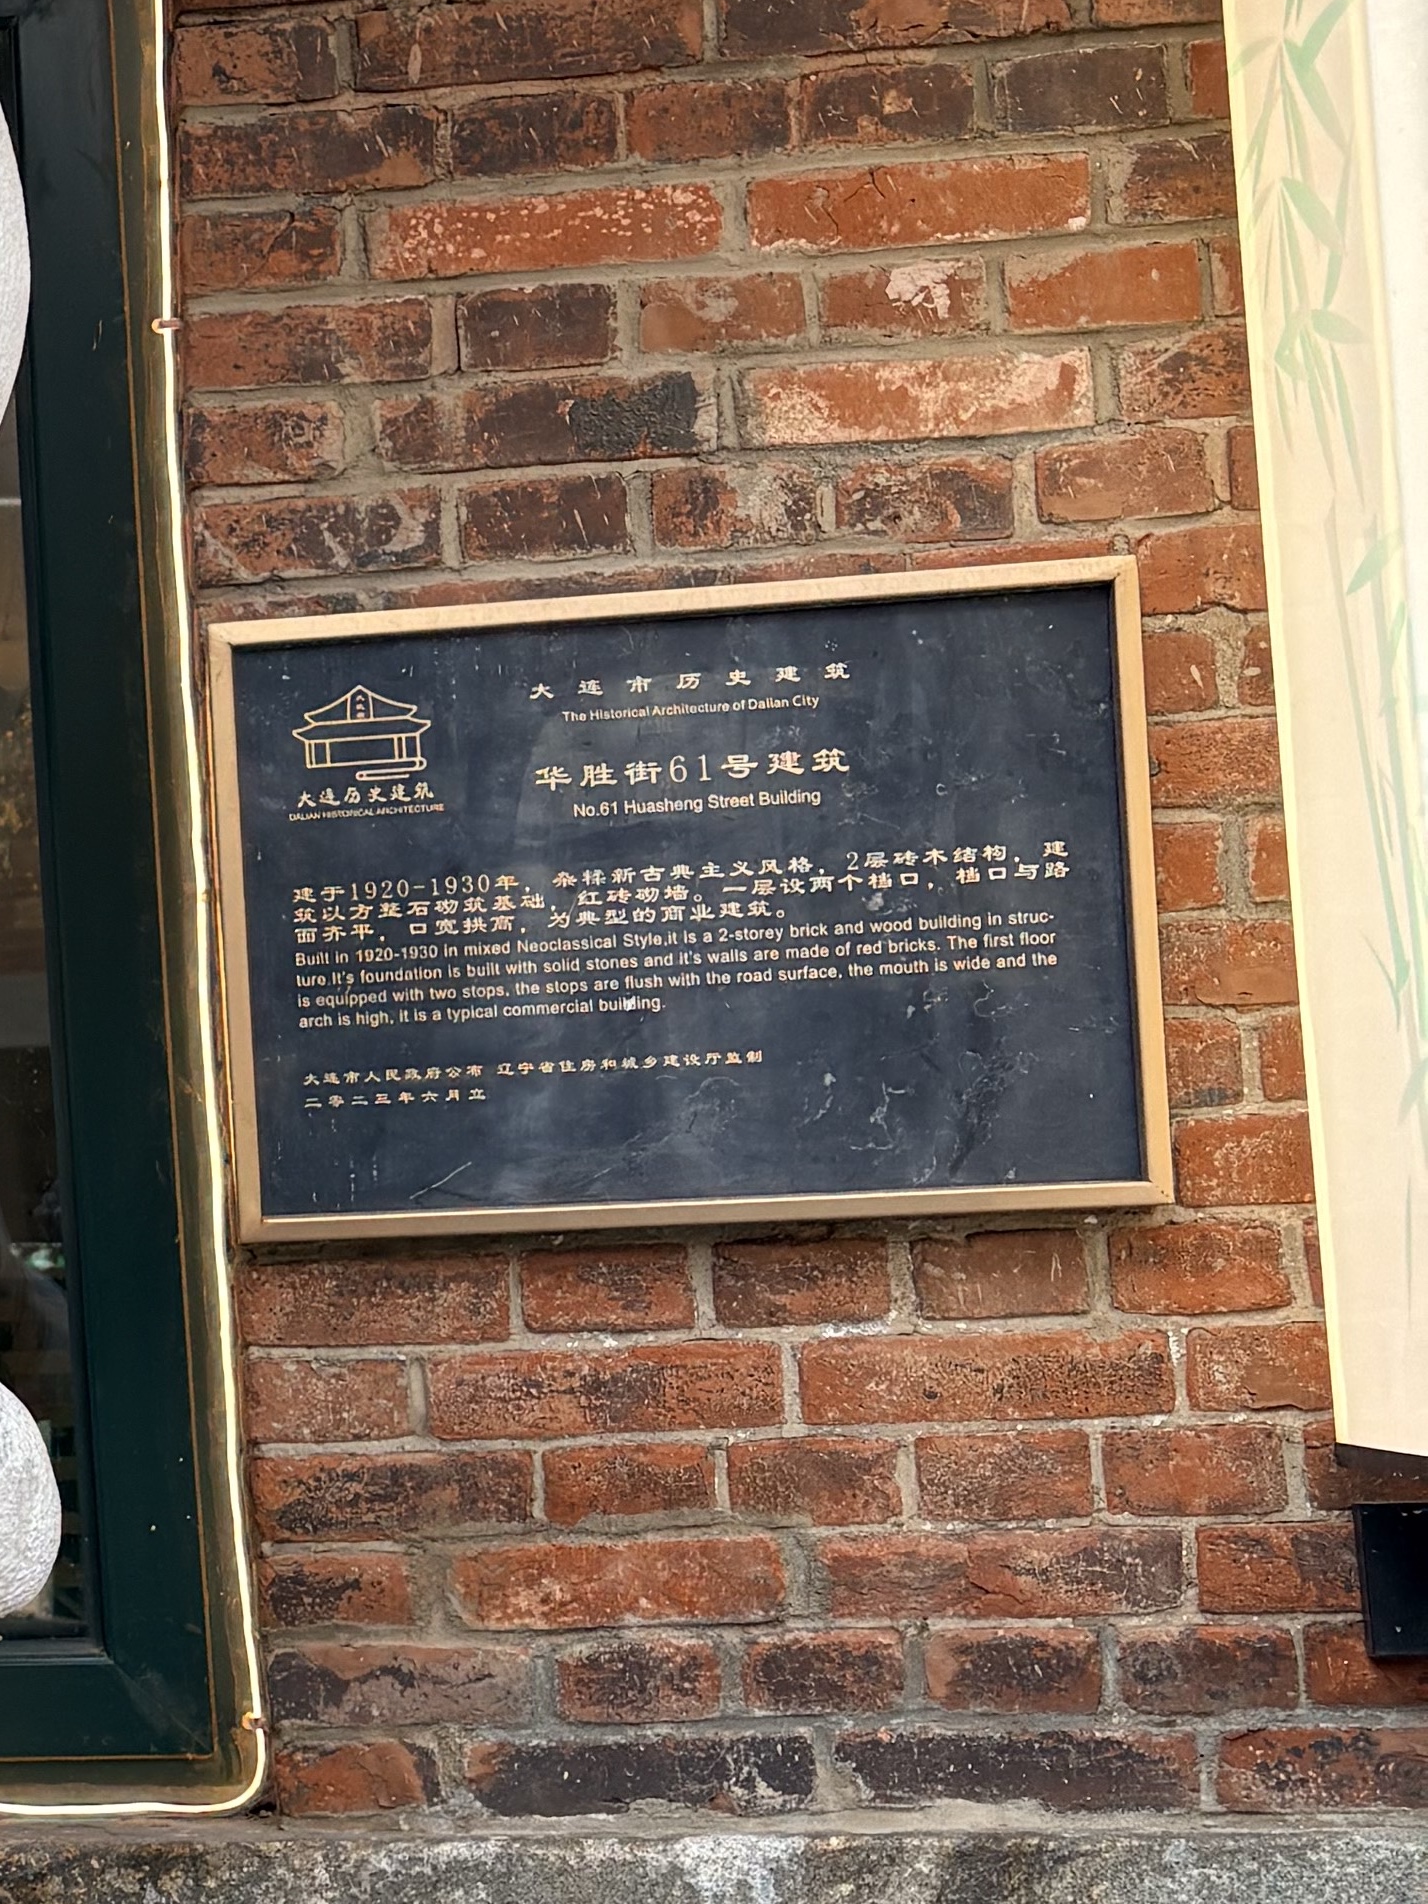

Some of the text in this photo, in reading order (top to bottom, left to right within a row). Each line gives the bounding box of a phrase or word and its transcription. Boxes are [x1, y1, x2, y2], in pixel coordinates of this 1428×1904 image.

[561, 694, 820, 722] The Historical Architecture of Dalian City
[534, 747, 850, 792] 华胜街61号建筑
[297, 781, 435, 809] 大连历史建筑
[573, 788, 822, 818] No.61 Huasheng Street Building
[288, 803, 445, 822] DALIAN HISTORICAL ARCHITECTURE
[295, 951, 330, 967] Built
[335, 950, 349, 964] in
[355, 944, 439, 963] 1920-1930
[443, 943, 459, 958] in
[463, 940, 511, 957] mixed
[517, 934, 617, 954] Neoclassical
[683, 929, 698, 944] is
[702, 931, 713, 944] a
[718, 927, 784, 943] 2-storey
[789, 922, 829, 939] brick
[834, 920, 865, 936] and
[869, 917, 913, 936] wood
[918, 913, 982, 931] building
[987, 911, 1003, 926] in
[359, 966, 443, 984] foundation
[447, 963, 462, 979] is
[466, 962, 501, 978] built
[505, 960, 538, 975] with
[543, 957, 581, 974] solid
[585, 956, 639, 971] stones
[643, 952, 674, 968] and
[679, 950, 703, 966] it's
[706, 948, 749, 964] walls
[753, 949, 780, 962] are
[785, 943, 830, 960] made
[834, 941, 852, 957] of
[856, 940, 887, 956] red
[887, 937, 941, 955] bricks.
[946, 935, 978, 951] The
[982, 933, 1015, 949] first
[1019, 931, 1057, 946] floor
[297, 993, 311, 1008] is
[315, 986, 388, 1009] equipped
[392, 987, 425, 1003] with
[429, 987, 457, 1001] two
[515, 981, 541, 996] the
[545, 980, 589, 996] stops
[593, 979, 620, 992] are
[624, 974, 664, 989] flush
[667, 971, 701, 987] with
[705, 970, 732, 985] the
[736, 967, 773, 984] road
[847, 962, 874, 978] the
[878, 957, 930, 976] mouth
[934, 958, 949, 973] is
[952, 955, 991, 971] wide
[996, 952, 1027, 969] and
[1031, 951, 1058, 967] the
[298, 1013, 333, 1029] arch
[337, 1012, 352, 1027] is
[399, 1009, 410, 1023] it
[413, 1008, 428, 1022] is
[431, 1009, 442, 1022] a
[446, 1004, 498, 1024] typical
[502, 998, 594, 1017] commercial
[598, 995, 667, 1013] building.
[303, 1087, 487, 1109] 二零二三年六月立
